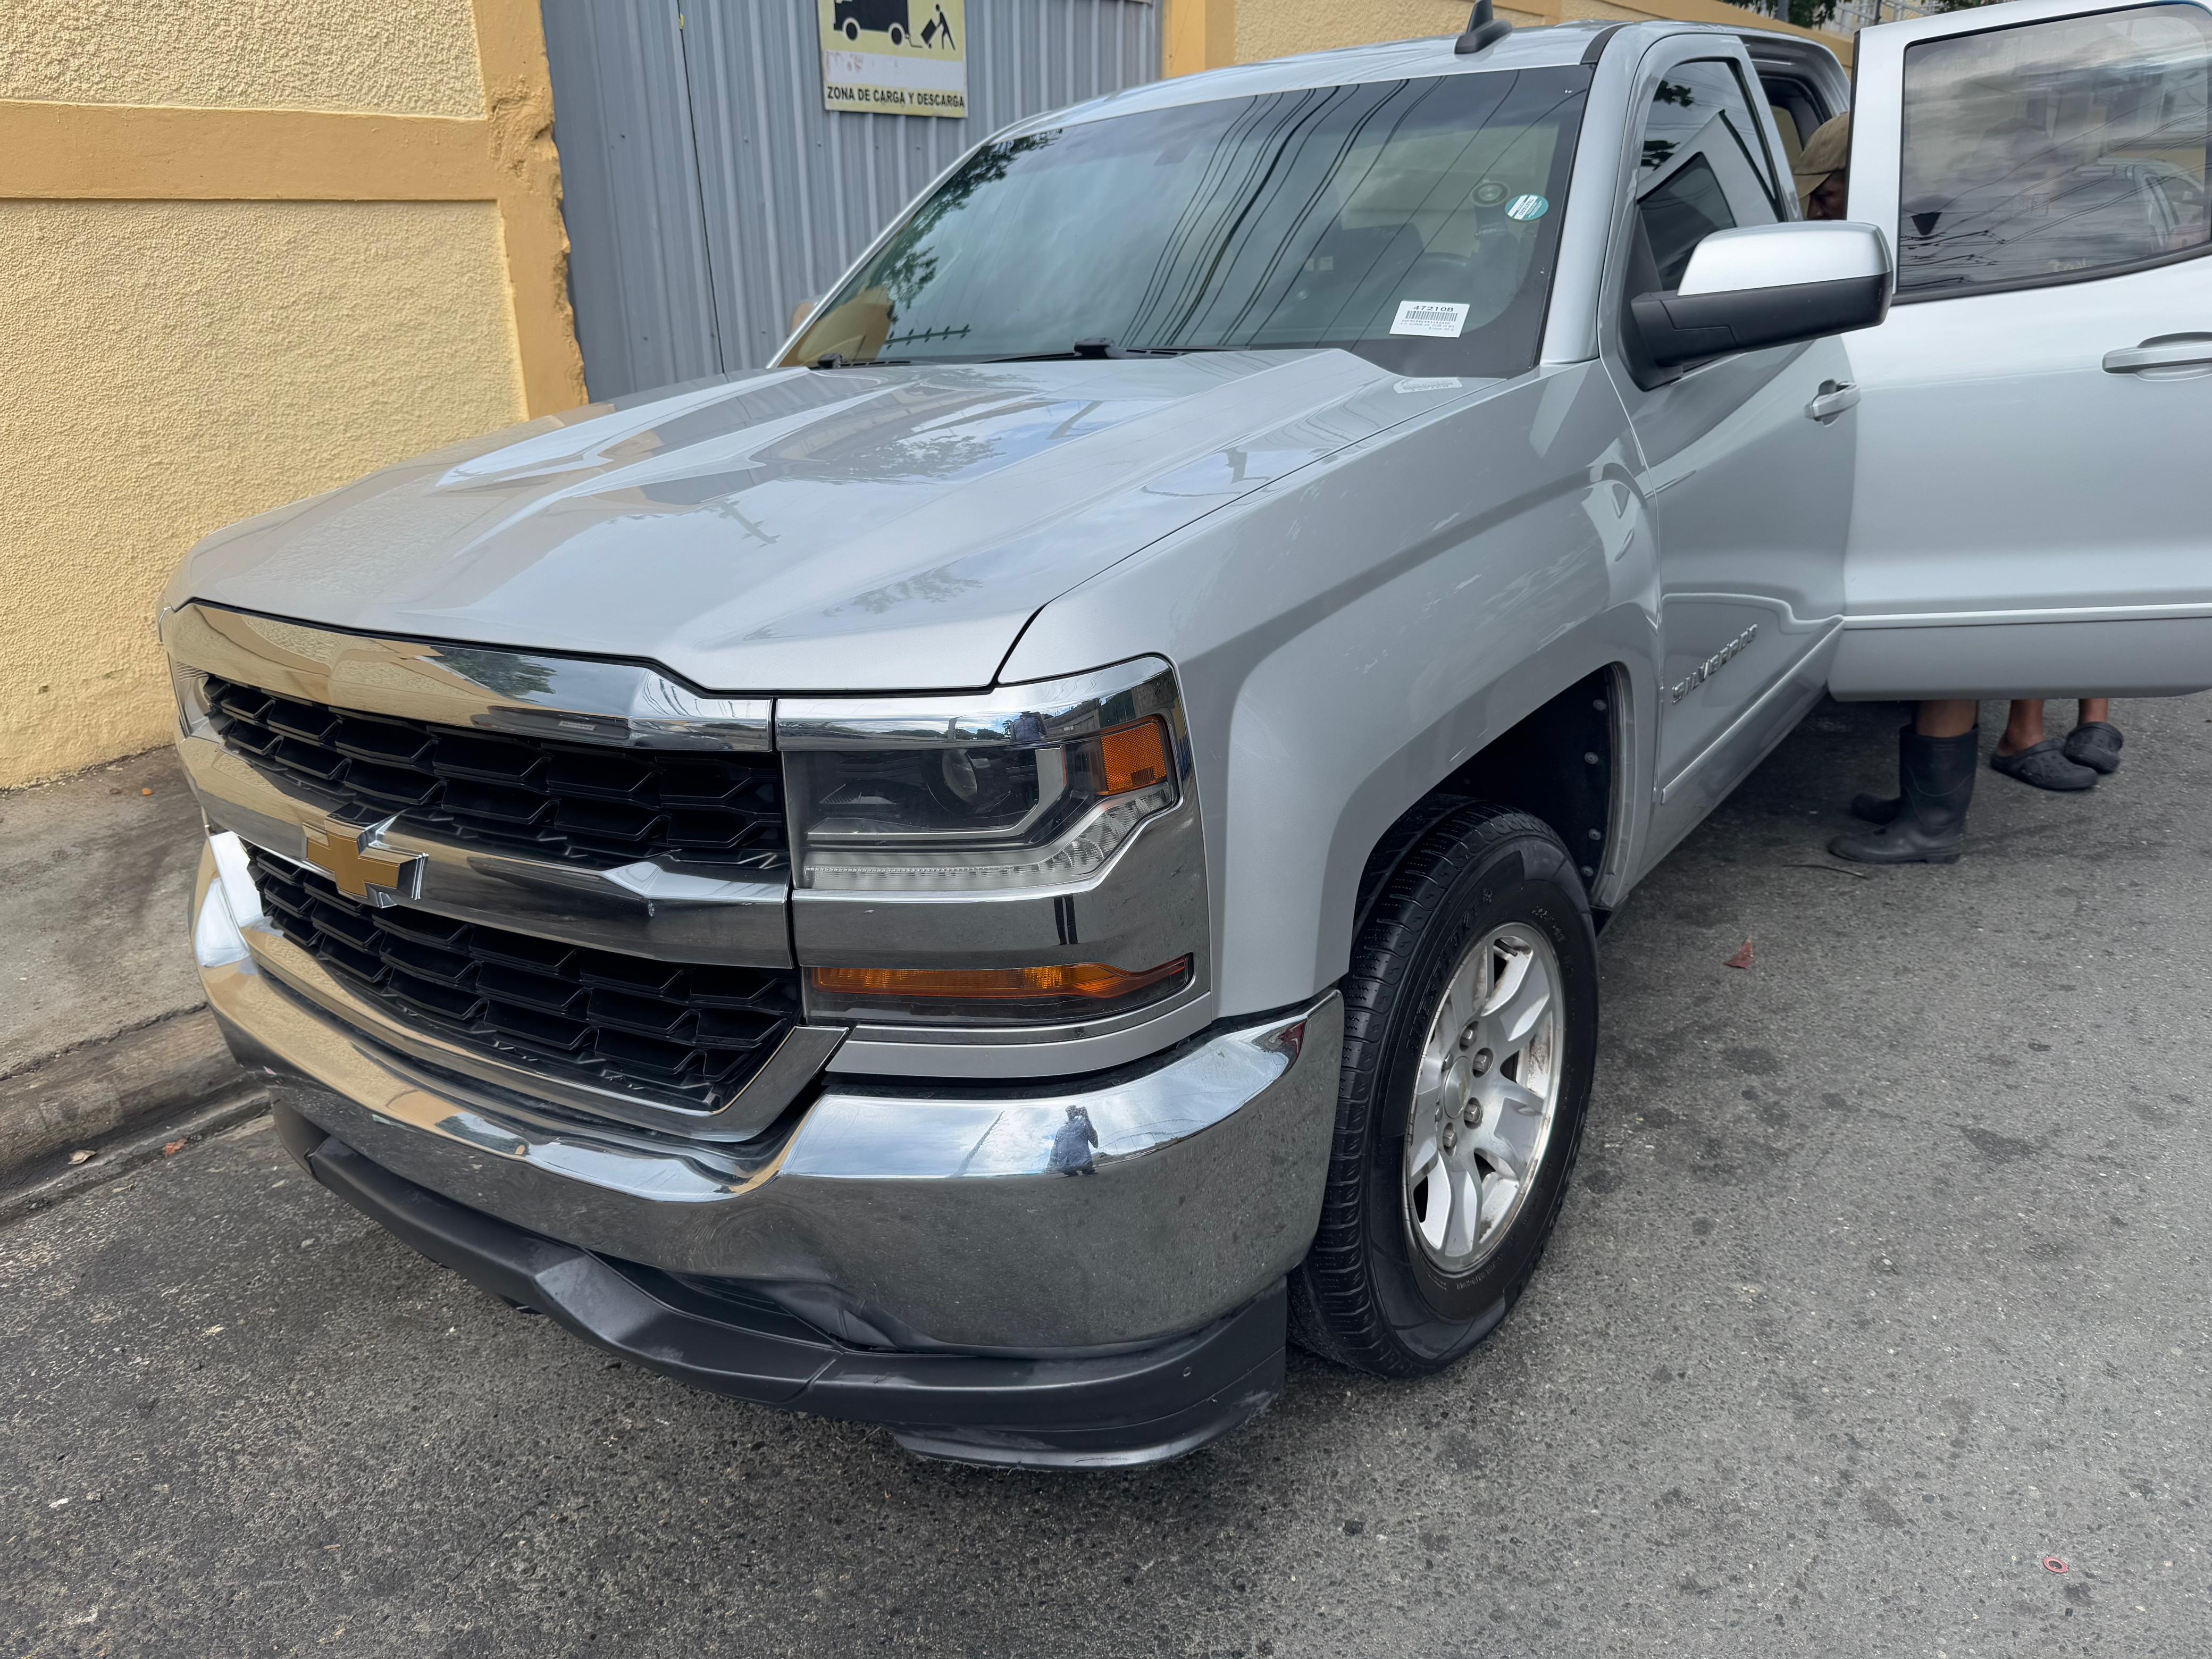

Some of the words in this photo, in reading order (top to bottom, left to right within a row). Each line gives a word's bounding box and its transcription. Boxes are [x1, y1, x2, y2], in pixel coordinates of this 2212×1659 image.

[827, 86, 855, 100] ZONA
[858, 88, 870, 102] DE
[874, 90, 905, 104] CARGA
[908, 92, 915, 104] Y
[917, 93, 965, 108] DESCARGA
[1671, 623, 1758, 705] SILVERADO
